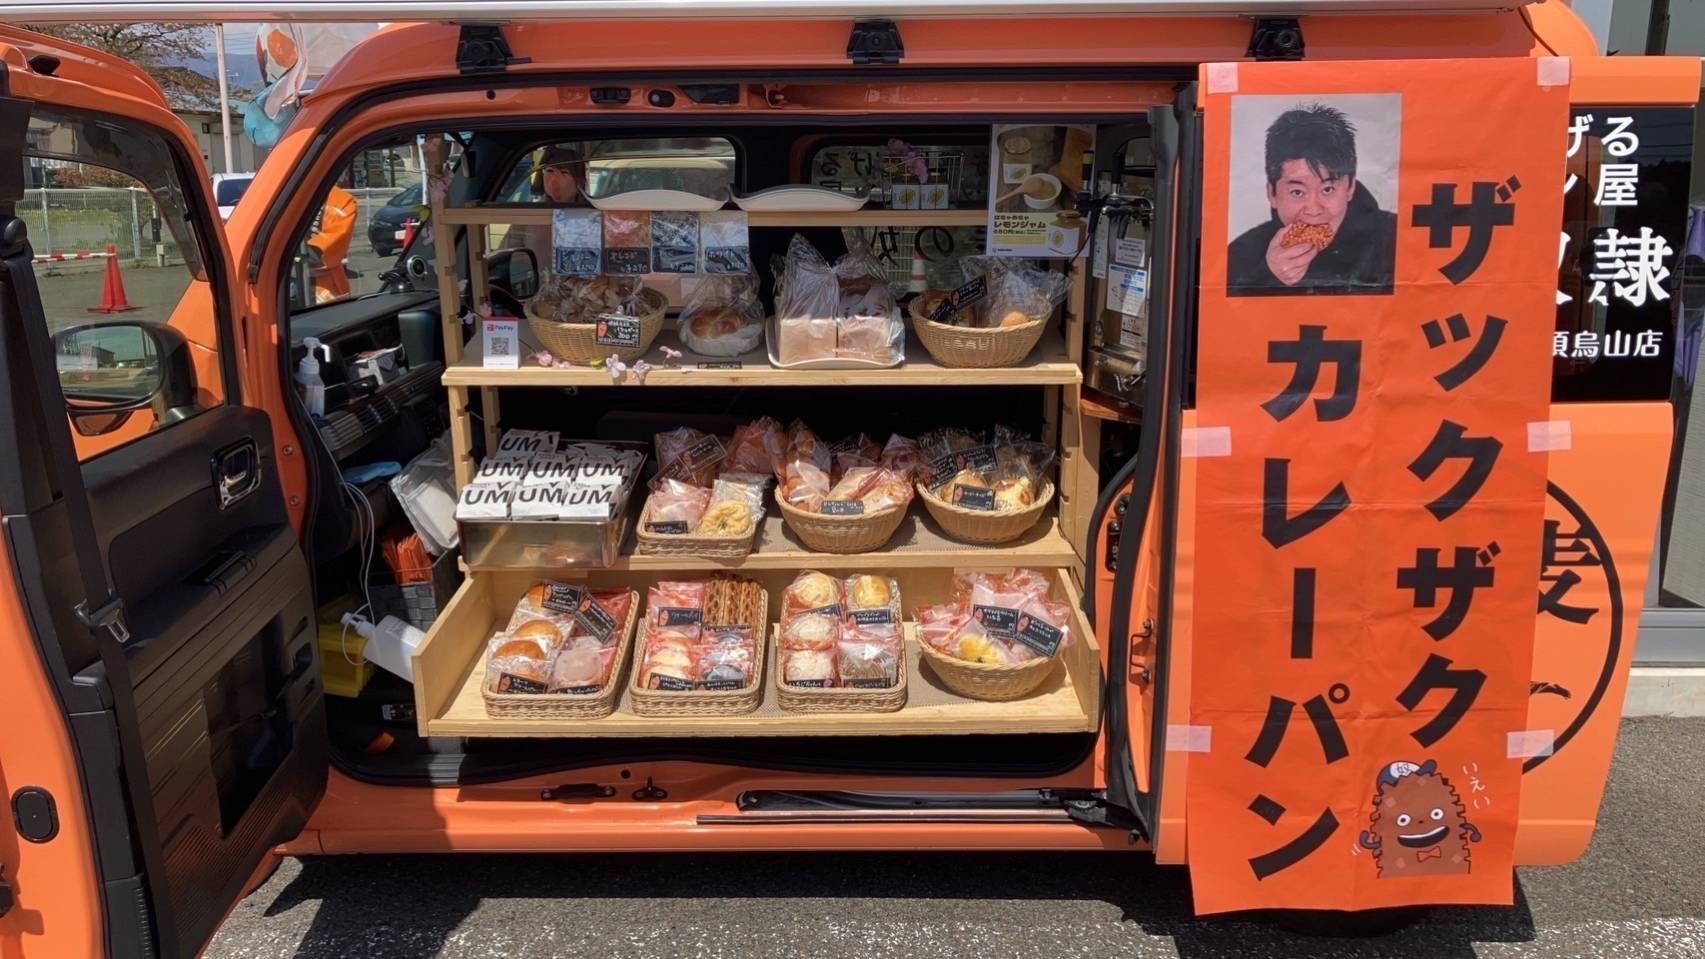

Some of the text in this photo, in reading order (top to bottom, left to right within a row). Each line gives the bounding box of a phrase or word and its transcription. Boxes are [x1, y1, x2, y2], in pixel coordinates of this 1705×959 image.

[993, 220, 1047, 229] レモンジャム
[1556, 226, 1674, 307] 隷
[1396, 175, 1522, 749] ザックザク
[1244, 324, 1362, 881] カレーパン
[1463, 762, 1491, 809] いえい
